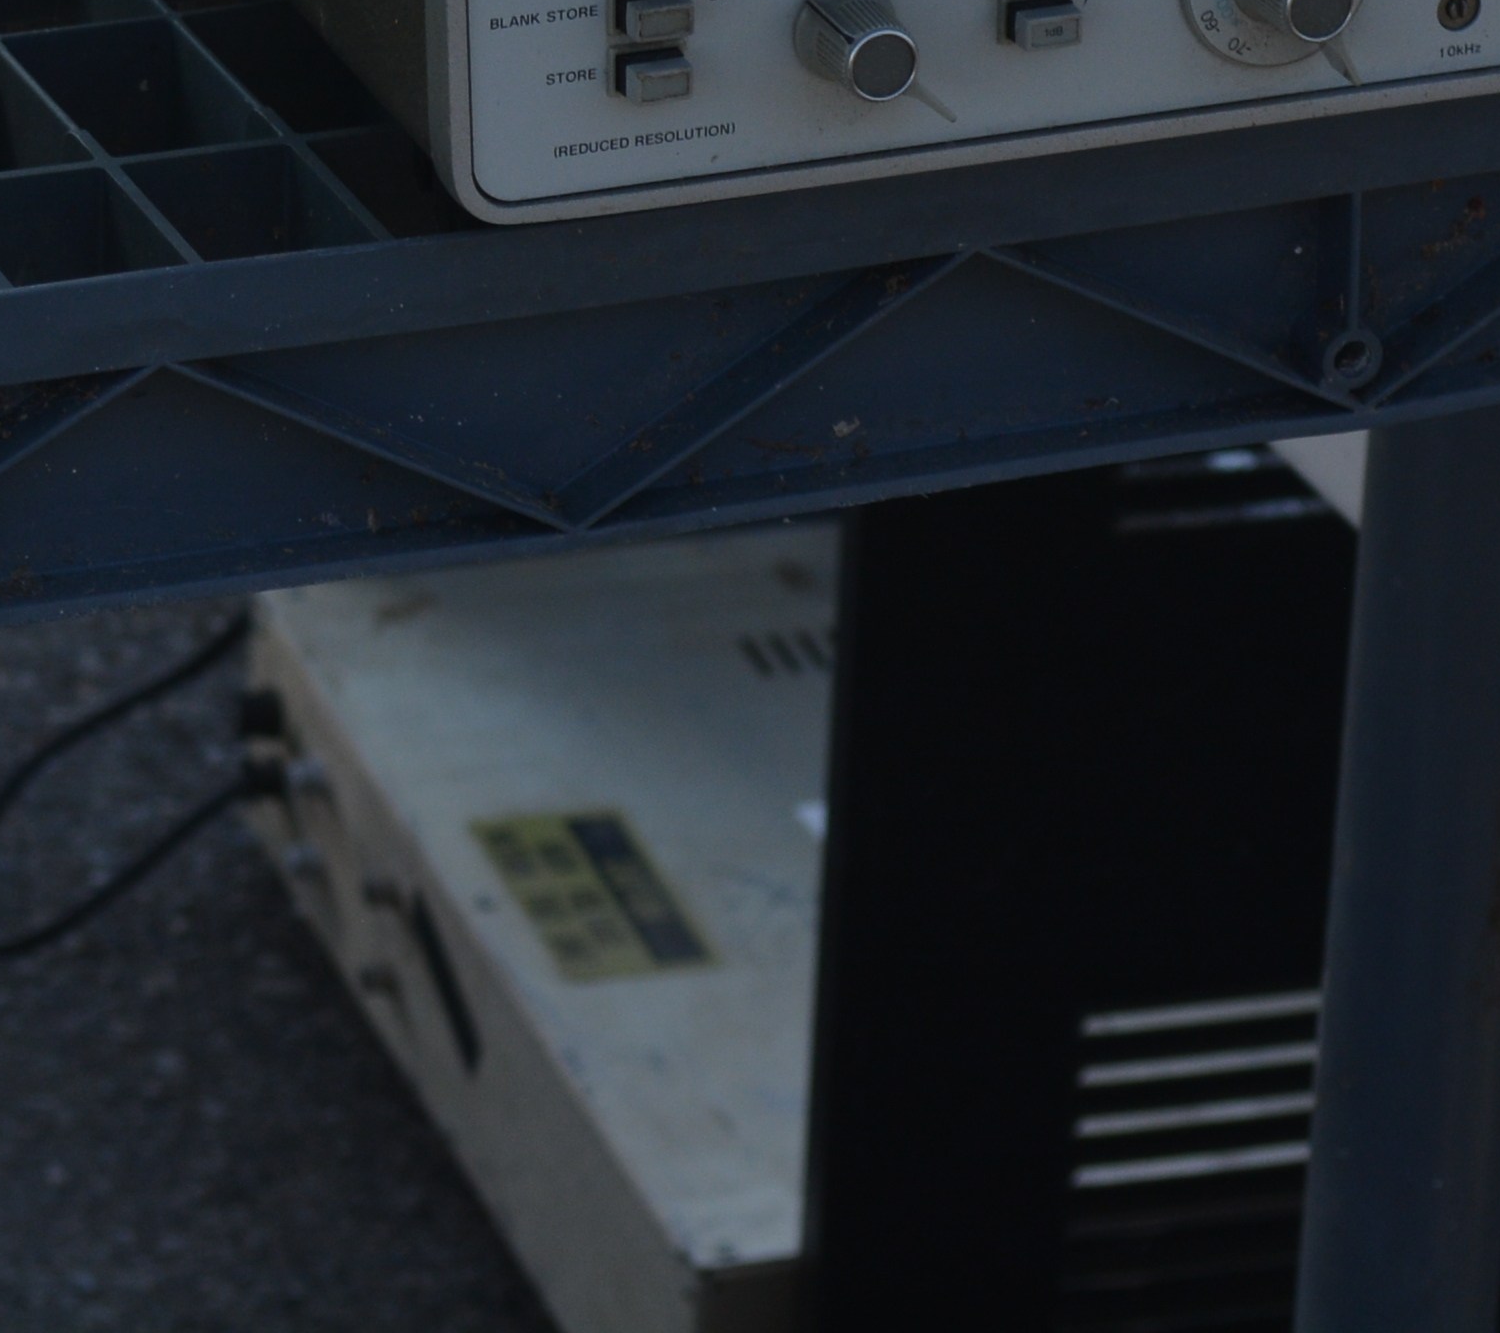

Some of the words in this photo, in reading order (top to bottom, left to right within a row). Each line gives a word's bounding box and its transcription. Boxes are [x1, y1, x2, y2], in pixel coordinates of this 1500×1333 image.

[490, 12, 540, 30] BLANK
[547, 5, 599, 24] STORE
[546, 68, 597, 85] STORE
[553, 136, 630, 159] (REDUCED
[635, 121, 736, 149] RESOLUTION)
